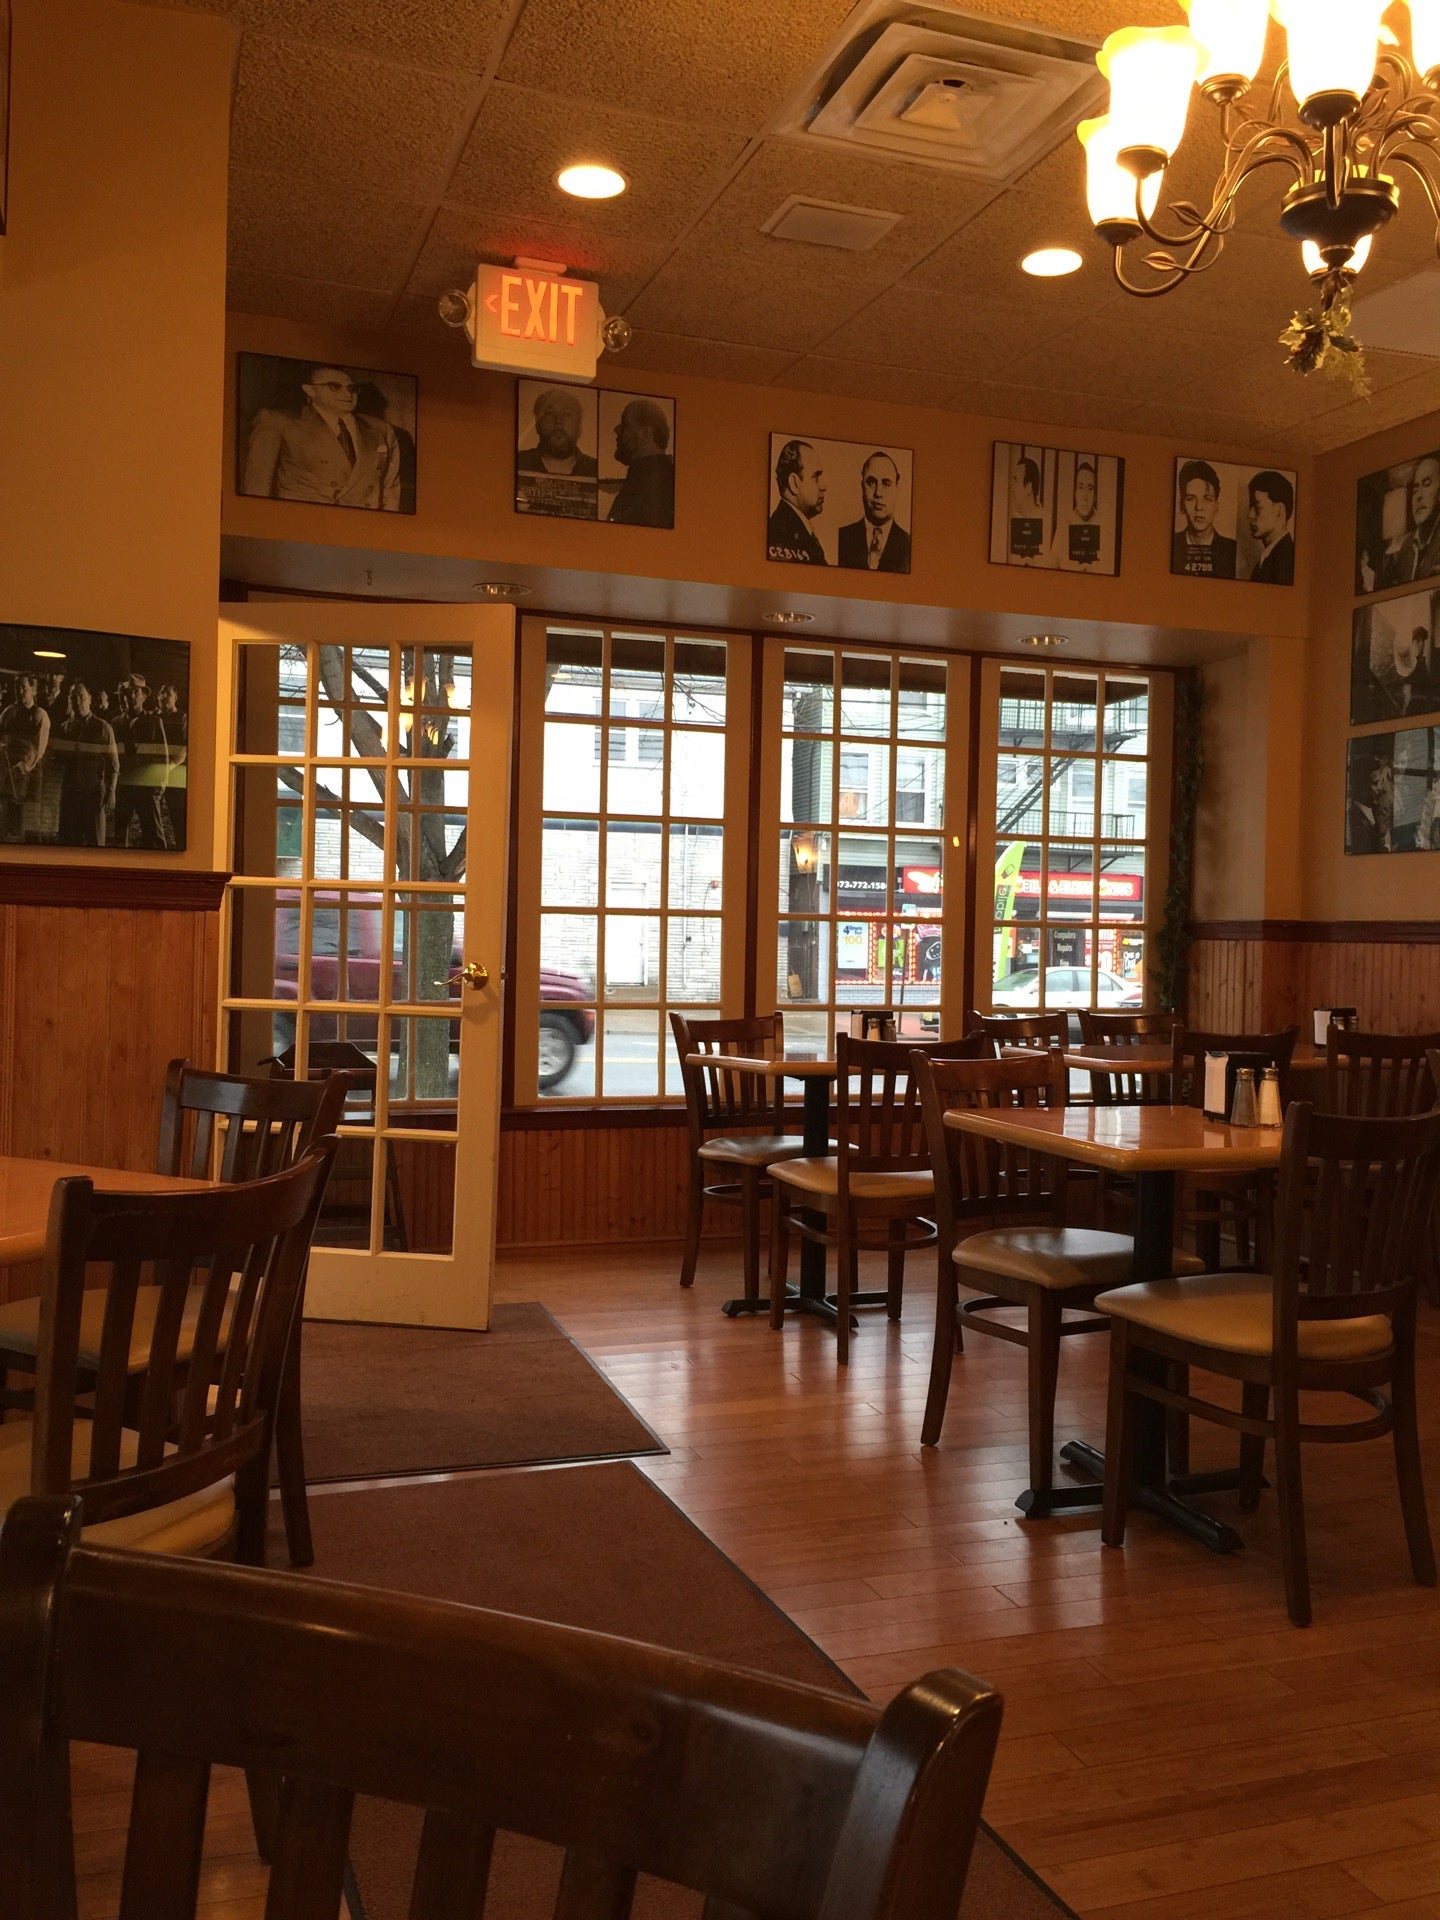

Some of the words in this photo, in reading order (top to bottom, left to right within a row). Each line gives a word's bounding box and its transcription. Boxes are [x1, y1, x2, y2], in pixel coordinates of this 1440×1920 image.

[500, 274, 583, 346] EXIT
[769, 546, 810, 561] C28169
[843, 925, 850, 935] 4
